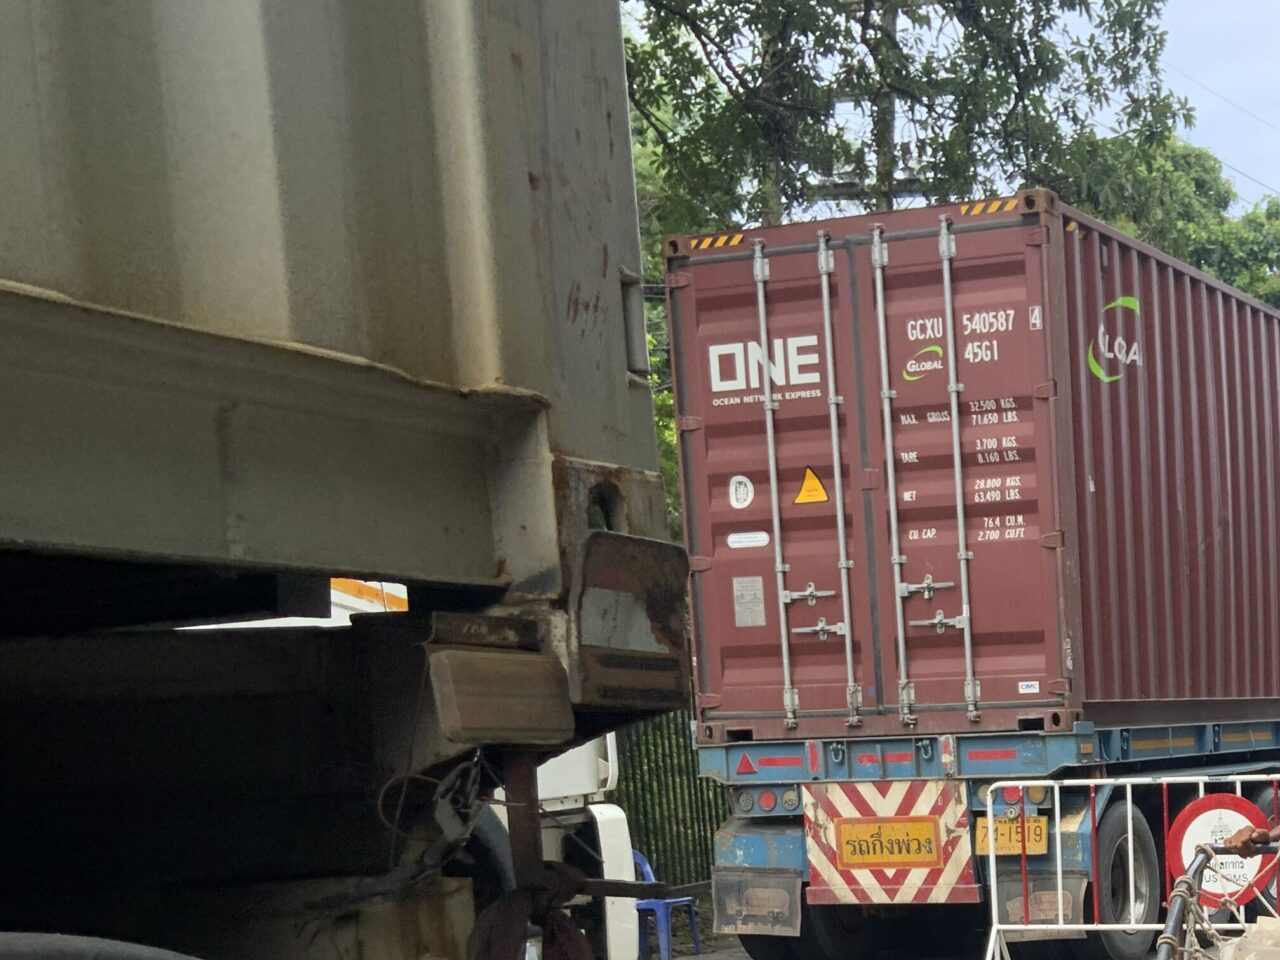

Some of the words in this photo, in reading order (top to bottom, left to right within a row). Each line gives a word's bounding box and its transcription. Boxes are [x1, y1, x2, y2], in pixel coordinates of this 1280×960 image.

[907, 317, 943, 341] GCXU
[962, 309, 1016, 335] 540587
[1030, 307, 1041, 329] 4
[964, 340, 998, 363] 45G1
[709, 335, 820, 392] ONE
[906, 360, 944, 372] GLOBAL
[712, 397, 741, 406] OCEAN
[743, 392, 783, 403] NETWRK
[785, 389, 822, 400] EXPRESS
[927, 411, 950, 423] GROSS
[903, 491, 917, 501] NET
[983, 517, 1001, 529] 76.4
[845, 825, 933, 856] รถกึ่งพ่วง
[1203, 873, 1248, 883] USOMS
